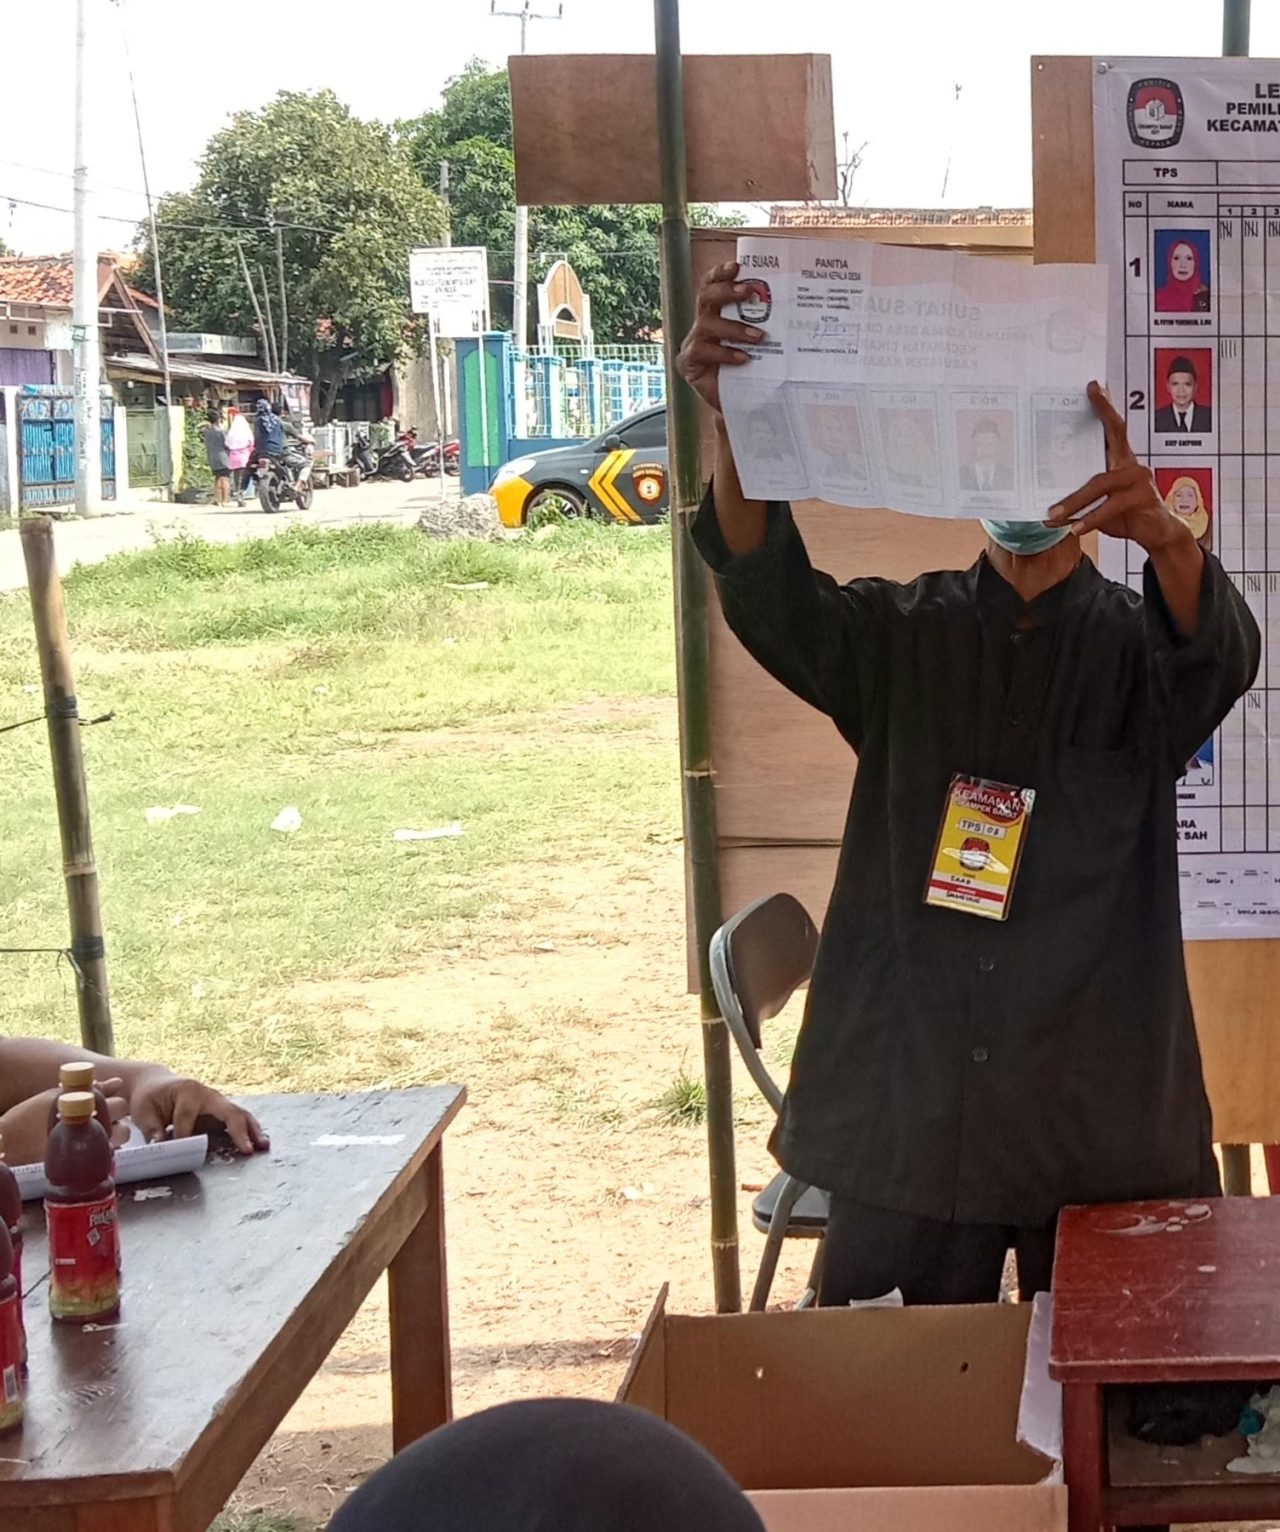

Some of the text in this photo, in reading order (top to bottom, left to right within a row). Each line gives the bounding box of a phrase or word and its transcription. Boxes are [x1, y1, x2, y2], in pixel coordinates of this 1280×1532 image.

[1153, 168, 1178, 178] TPS
[1128, 201, 1143, 209] NO
[1167, 201, 1194, 209] NAMA
[752, 255, 779, 268] SUARA
[815, 258, 849, 269] PANITIA
[1129, 257, 1141, 277] 1
[1129, 390, 1145, 410] 2
[952, 787, 1021, 812] KEAMANAN
[961, 820, 982, 832] TPS
[1184, 831, 1208, 841] SAH
